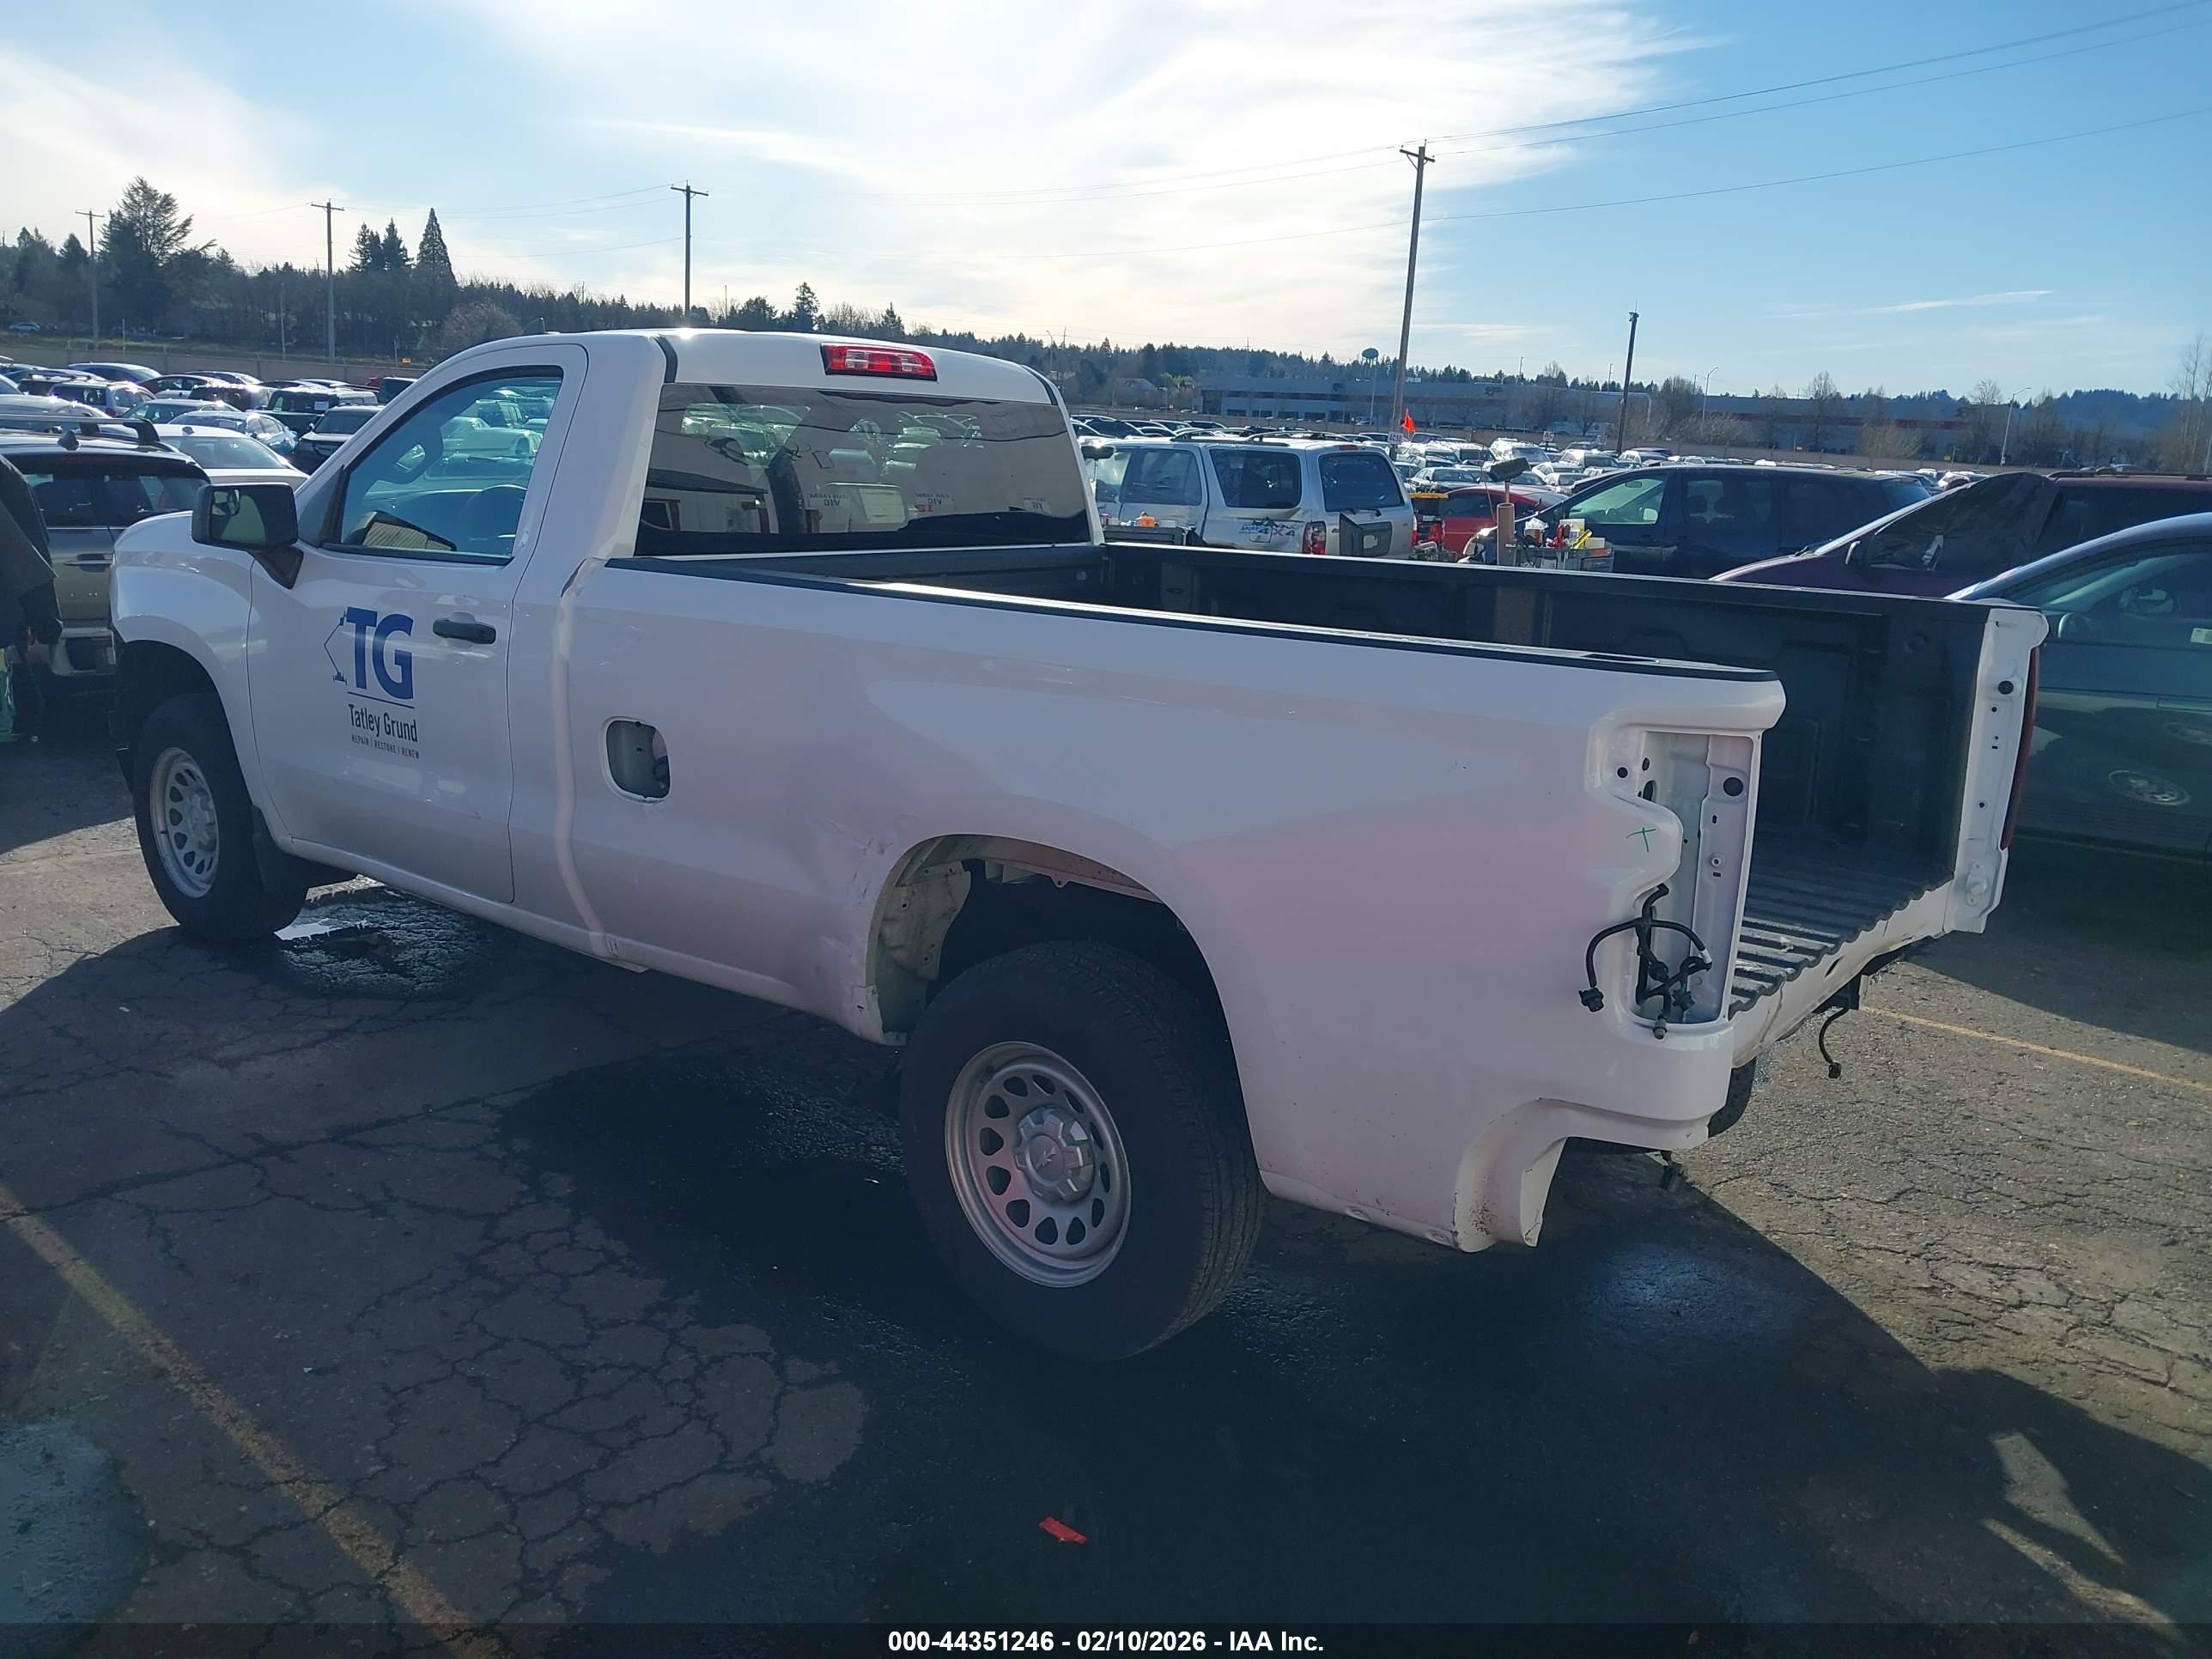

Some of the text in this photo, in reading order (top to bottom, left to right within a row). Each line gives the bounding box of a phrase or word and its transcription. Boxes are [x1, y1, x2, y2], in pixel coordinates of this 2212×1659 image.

[346, 606, 414, 699] TG
[348, 703, 418, 743] Tatley Grund
[351, 734, 369, 746] REPAIR
[374, 739, 397, 754] RESTORE
[401, 746, 420, 760] RENEW
